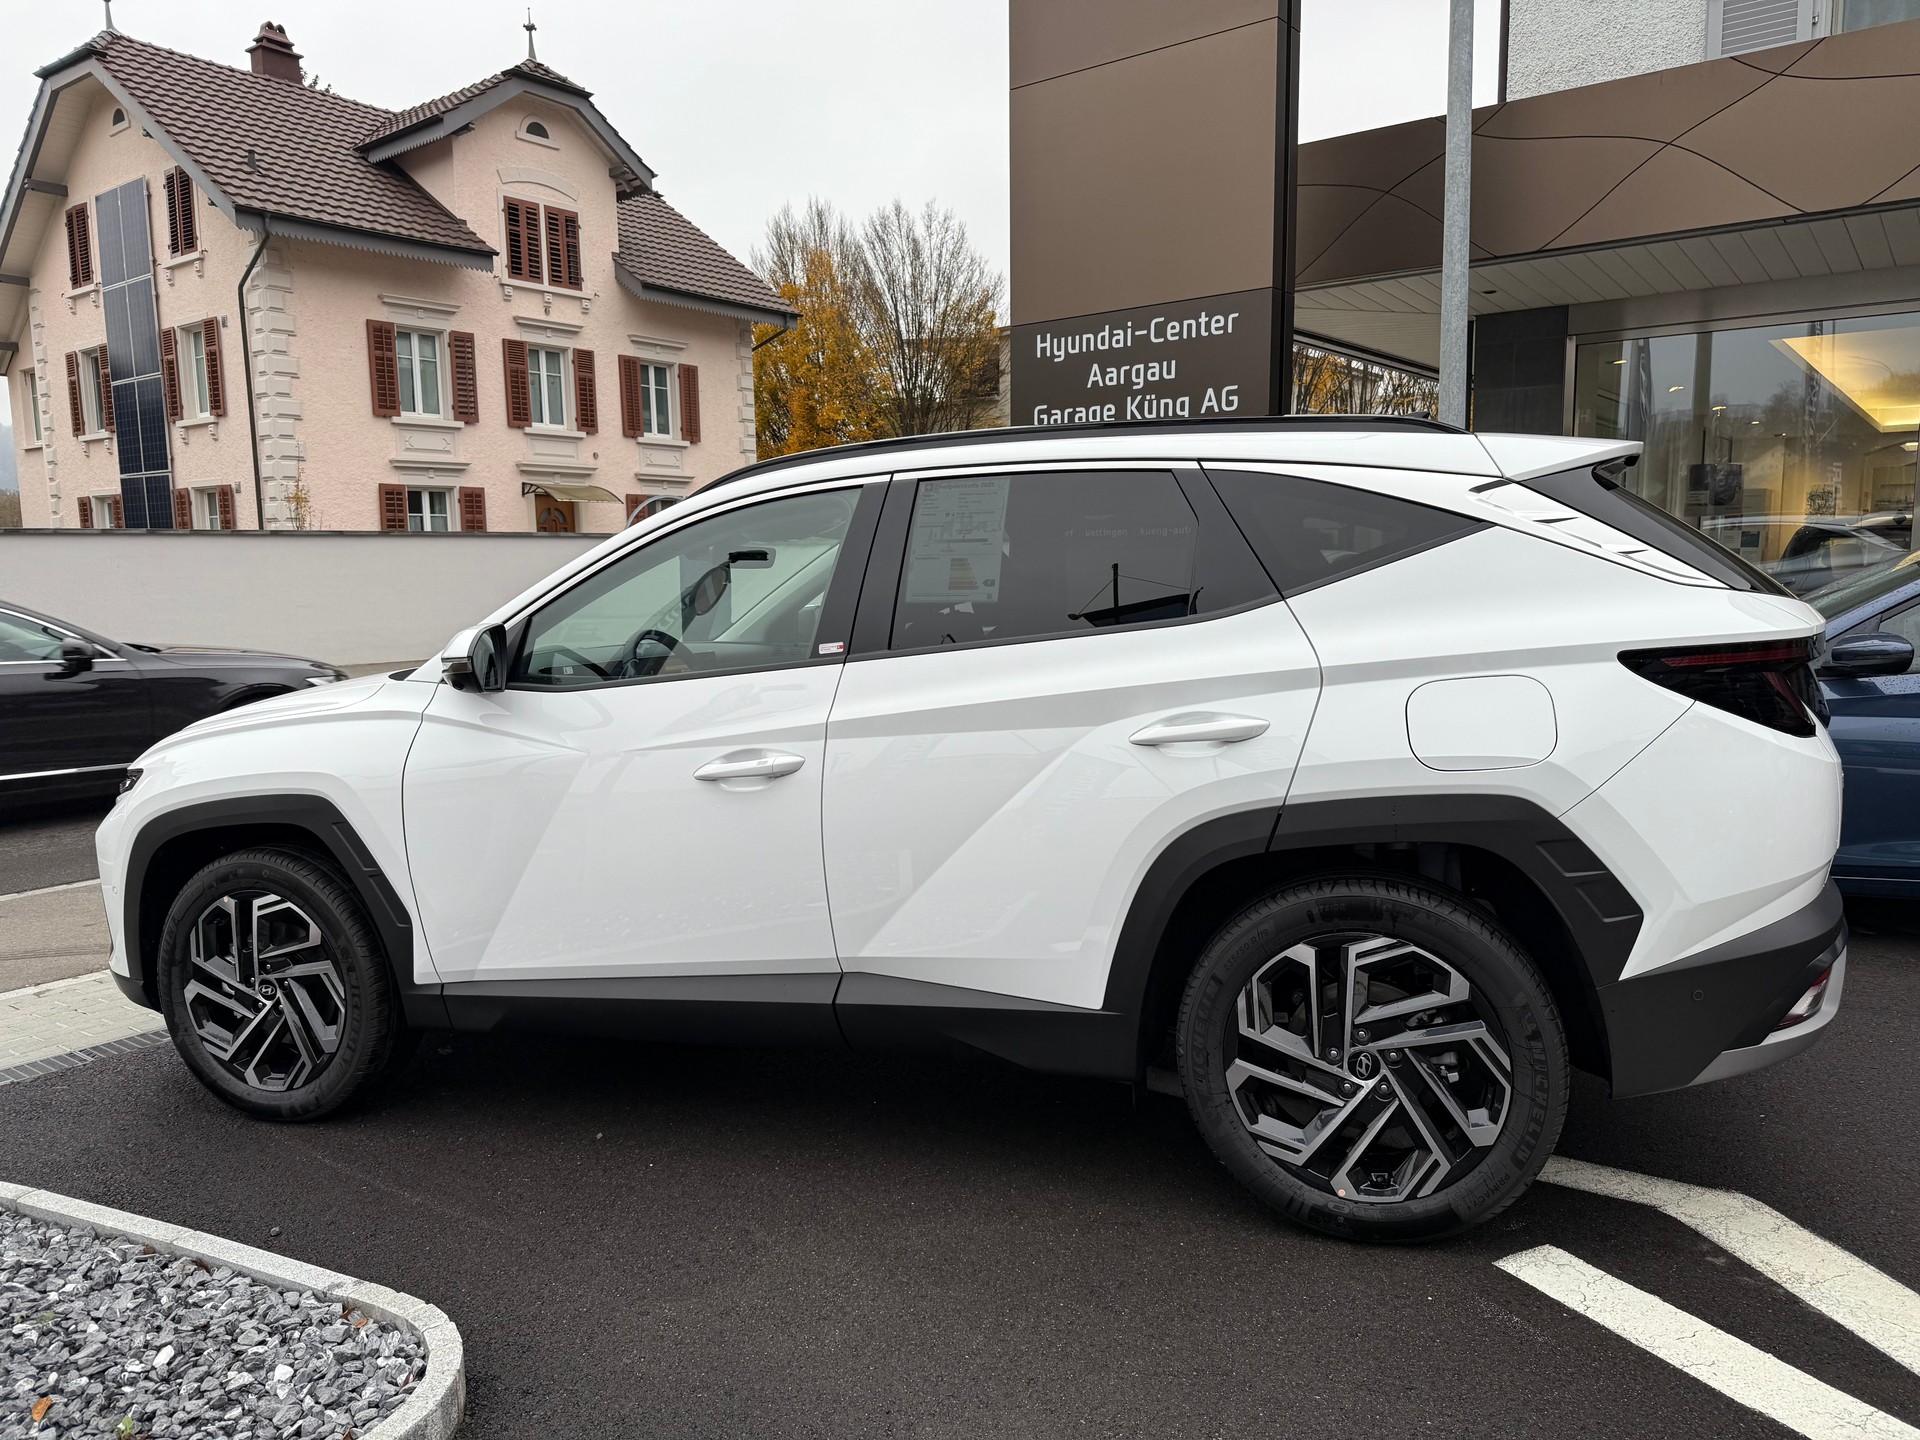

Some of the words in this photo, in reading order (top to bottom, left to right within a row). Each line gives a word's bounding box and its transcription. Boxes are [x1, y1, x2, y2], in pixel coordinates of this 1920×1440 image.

[1036, 312, 1239, 362] Hyundai-Center
[1087, 359, 1176, 390] Aargau
[1033, 403, 1116, 426] Garage
[1200, 384, 1239, 414] AG
[1515, 1040, 1548, 1164] MICHELIN
